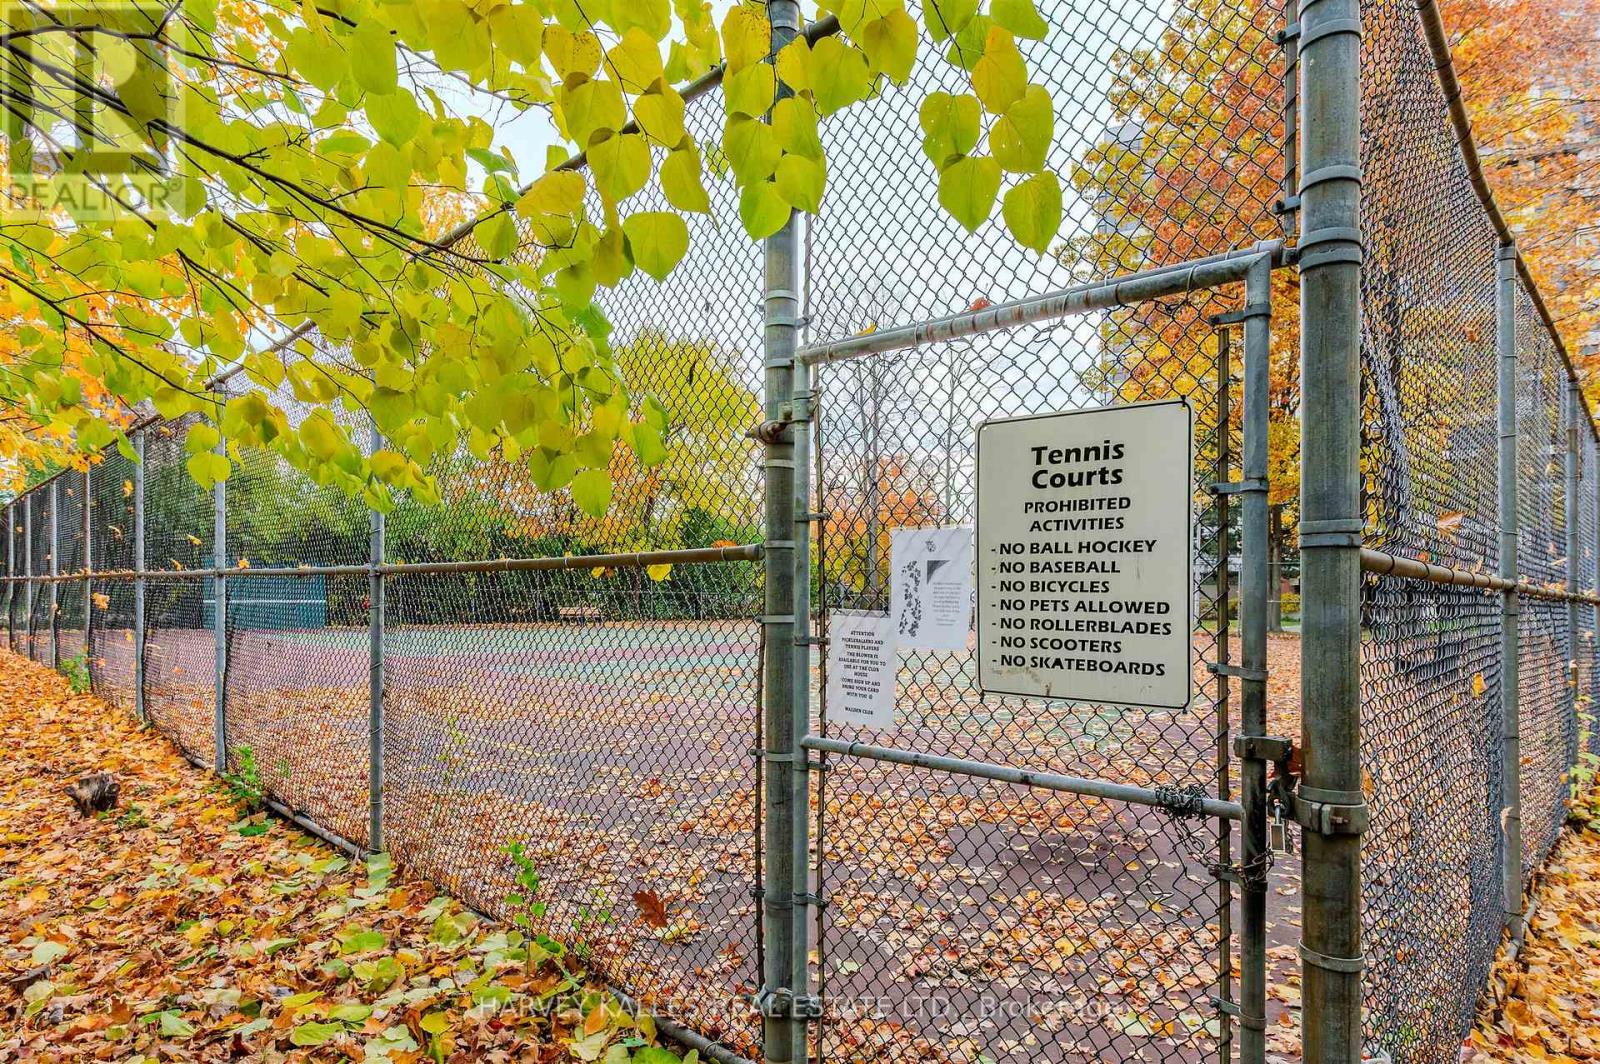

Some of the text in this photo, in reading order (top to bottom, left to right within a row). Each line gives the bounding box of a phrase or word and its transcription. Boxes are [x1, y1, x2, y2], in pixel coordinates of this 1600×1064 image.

[1032, 440, 1124, 465] Tennis
[1032, 467, 1123, 489] Courts
[1024, 497, 1131, 513] PROHIBITED
[1029, 517, 1124, 532] ACTIVITIES
[1030, 542, 1073, 554] BALL
[1078, 540, 1157, 553] HOCKEY
[1030, 561, 1120, 573] BASEBALL
[1030, 581, 1109, 593] BICYCLES
[1030, 600, 1069, 612] PETS
[1074, 601, 1169, 614] ALLOWED
[1030, 619, 1172, 635] ROLLERBLADES
[1030, 637, 1122, 653] SCOOTERS
[1030, 656, 1165, 676] SKATEBOARDS
